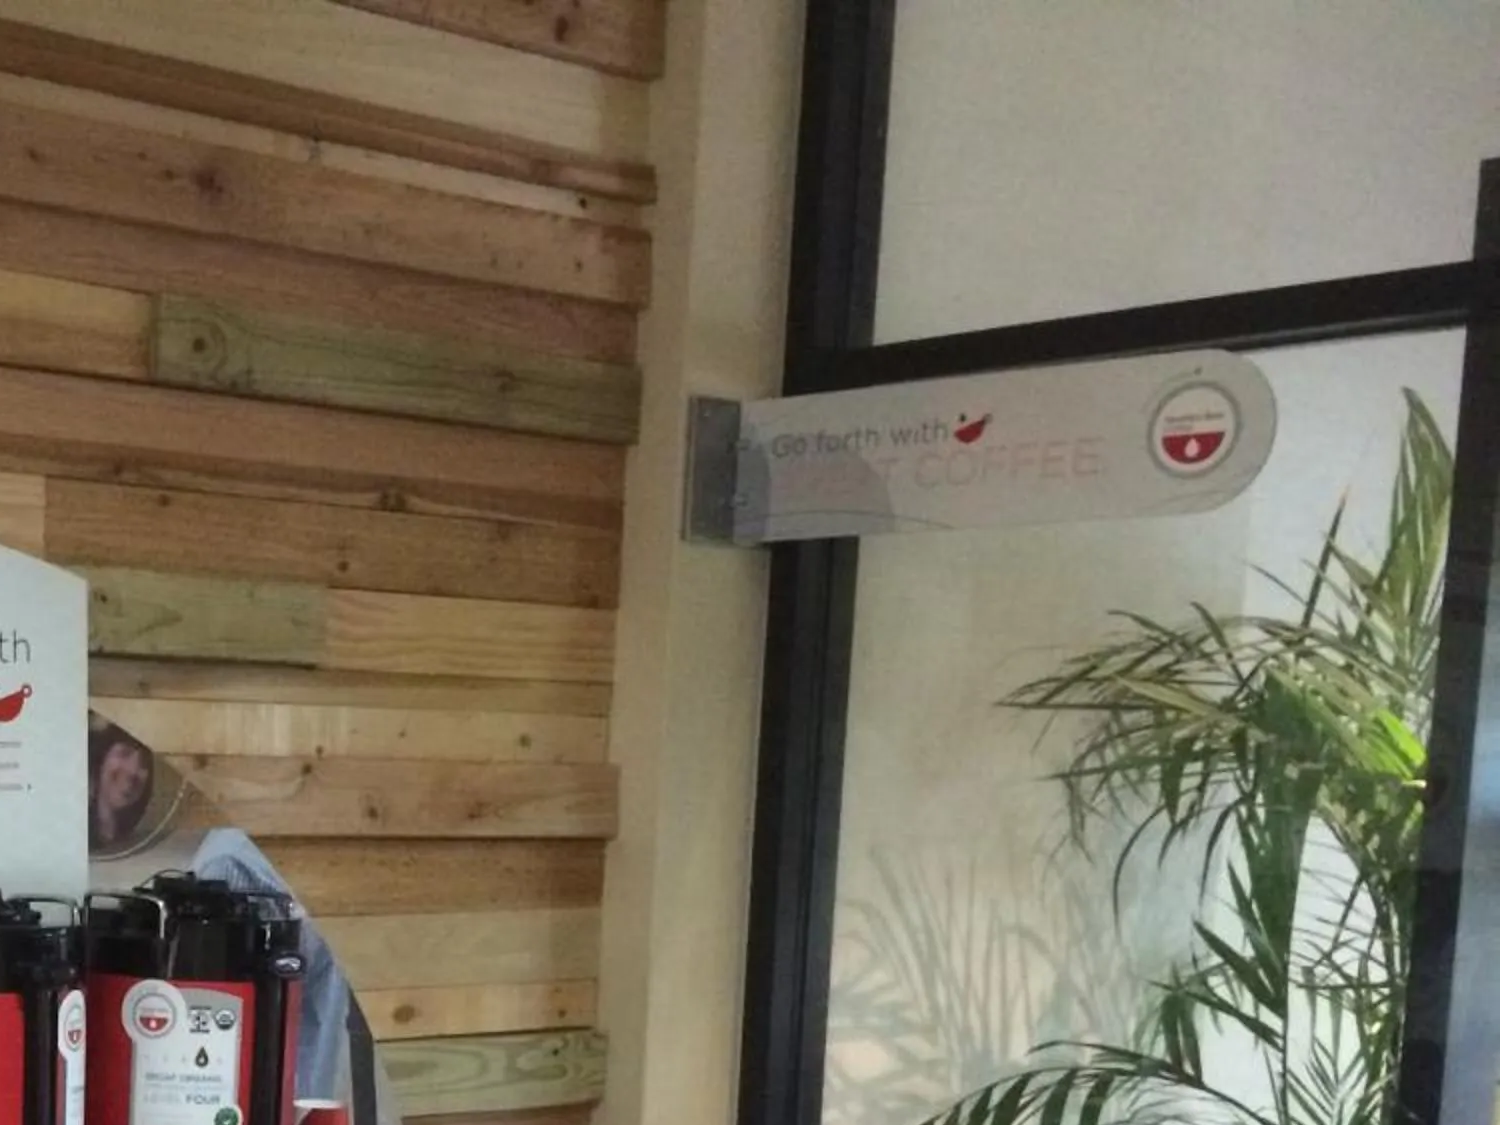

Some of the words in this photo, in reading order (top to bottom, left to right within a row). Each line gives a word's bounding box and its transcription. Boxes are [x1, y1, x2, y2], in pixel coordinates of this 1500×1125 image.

[770, 433, 807, 459] Go
[816, 424, 880, 455] forth
[889, 417, 949, 447] with
